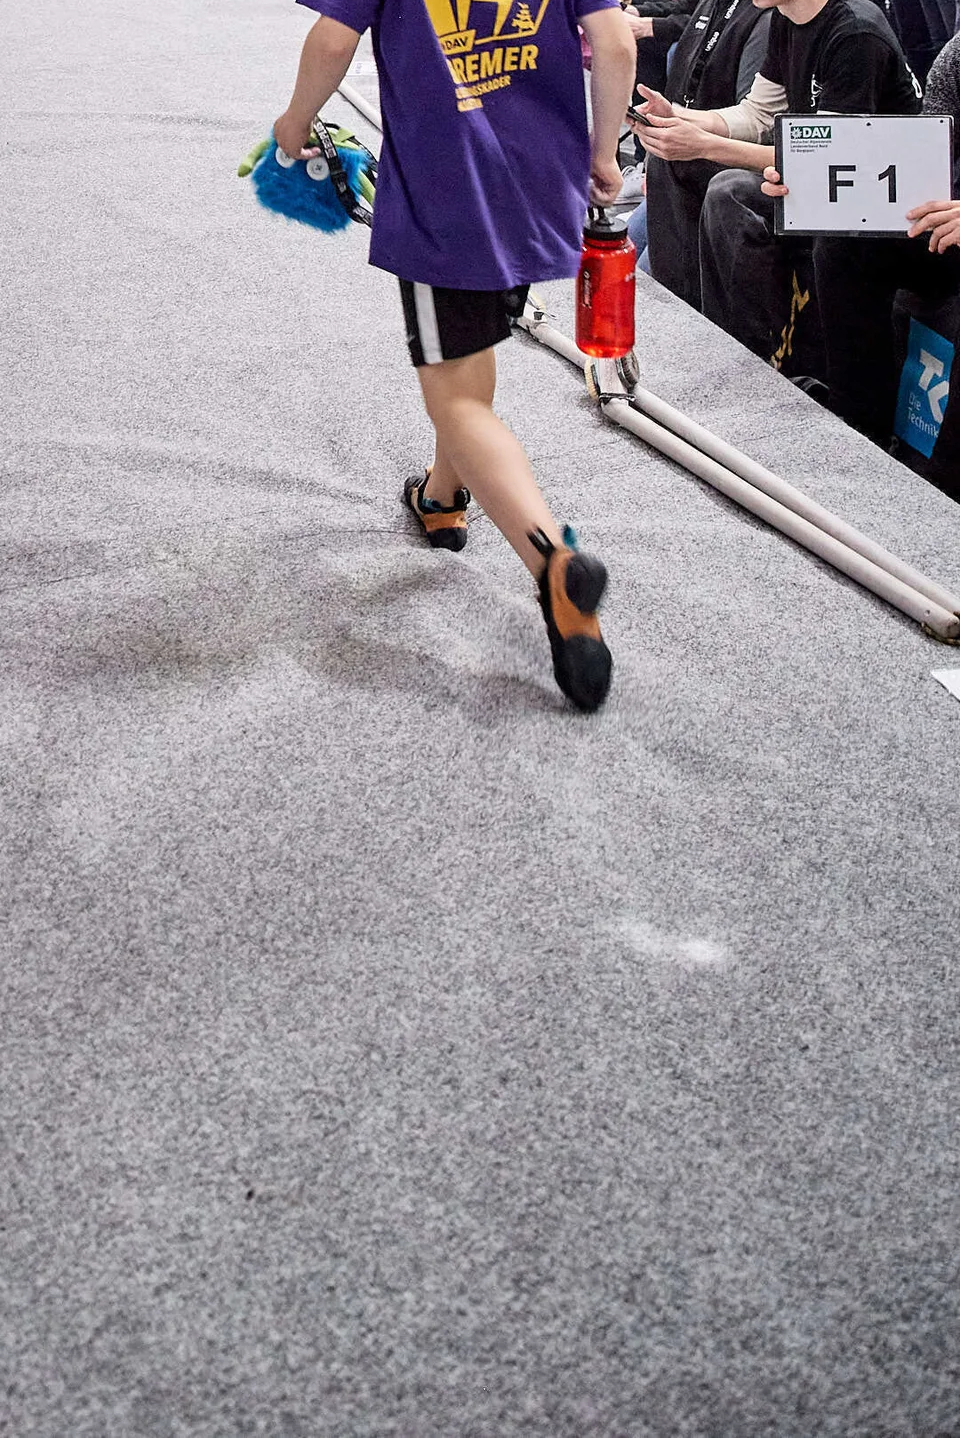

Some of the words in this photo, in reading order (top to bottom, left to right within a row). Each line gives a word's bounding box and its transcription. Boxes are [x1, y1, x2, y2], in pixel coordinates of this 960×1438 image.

[445, 36, 468, 50] DAV
[705, 31, 720, 52] unique
[802, 127, 830, 138] DAV
[828, 165, 857, 203] F
[878, 165, 897, 203] 1
